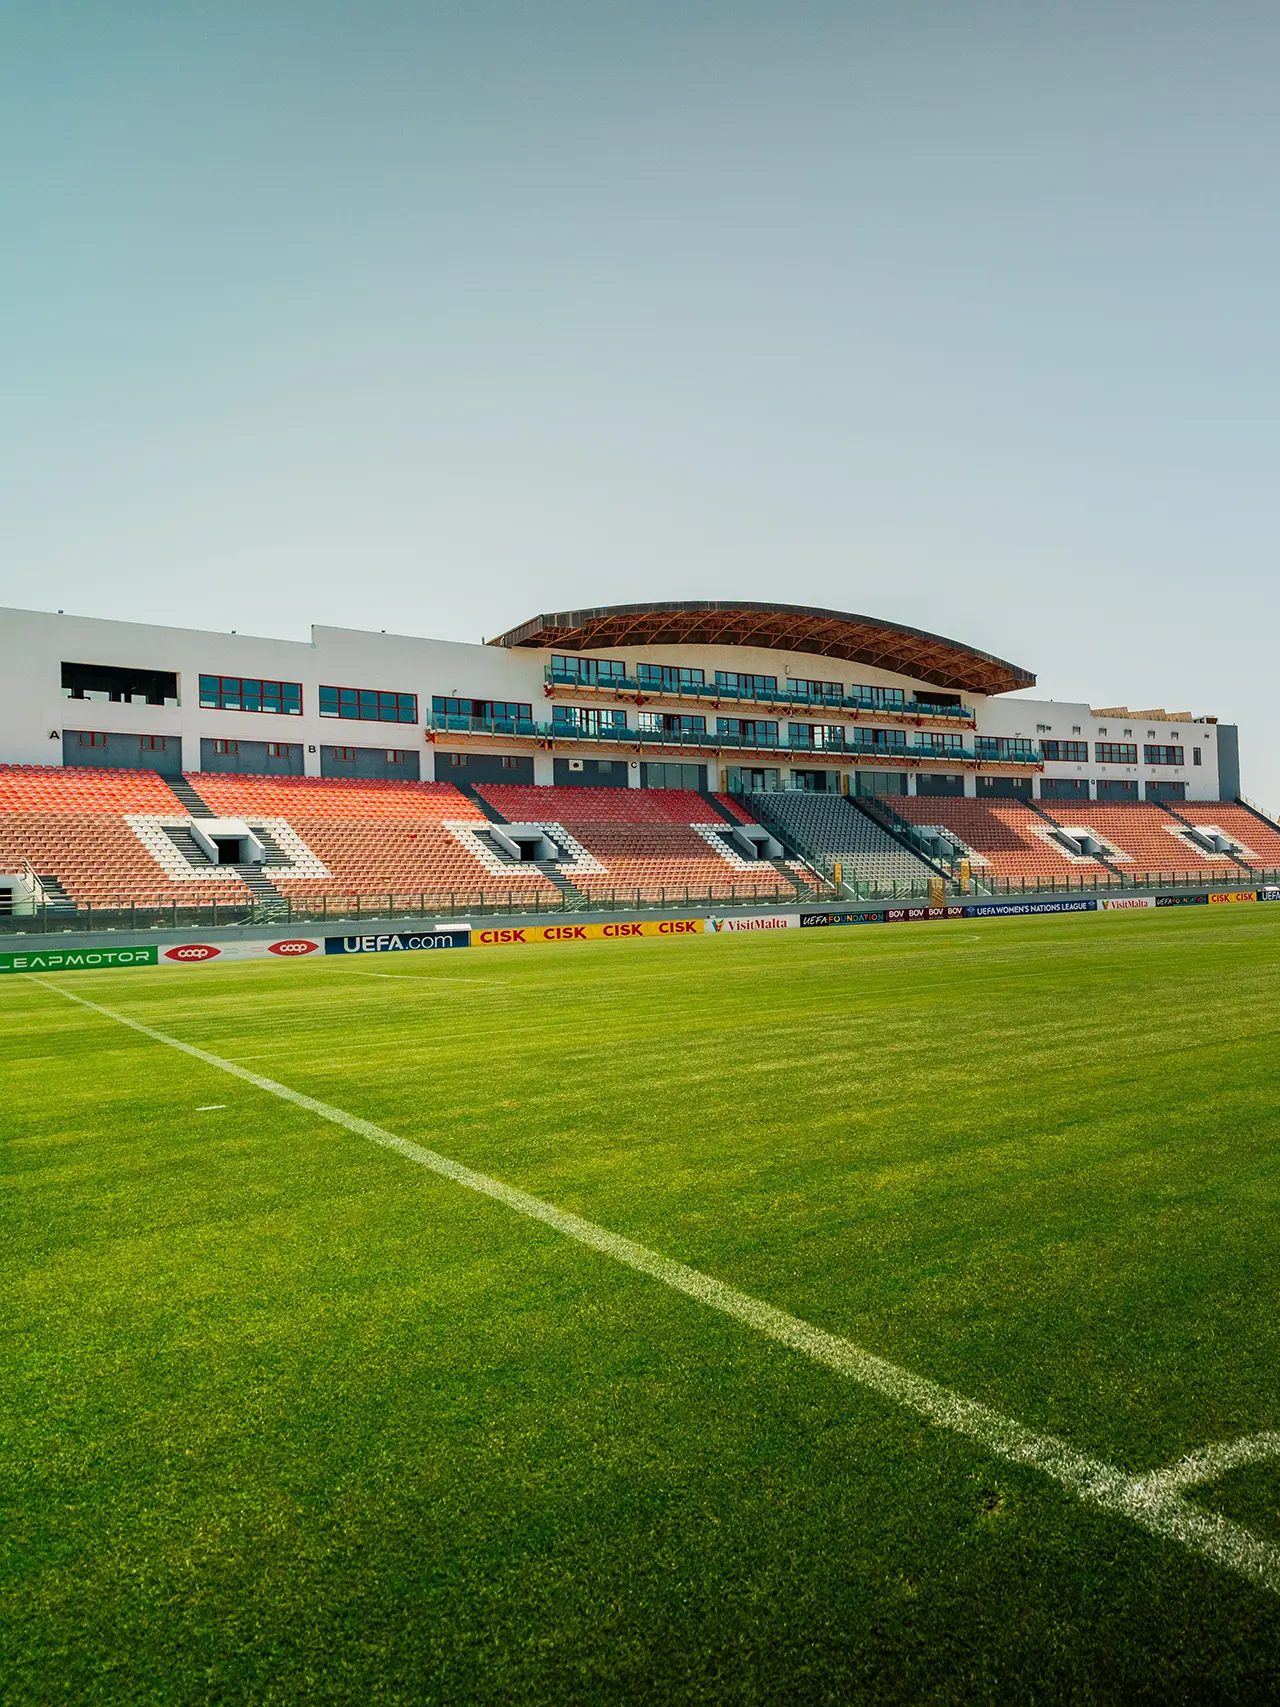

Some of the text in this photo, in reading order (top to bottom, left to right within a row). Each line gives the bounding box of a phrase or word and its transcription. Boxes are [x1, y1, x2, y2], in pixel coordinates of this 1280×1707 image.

[49, 730, 60, 739] A
[308, 745, 316, 753] B
[1211, 892, 1254, 903] CISK CISK
[977, 902, 1087, 915] UEFA WOMEN'S NATIONS LEAGUE
[1111, 899, 1148, 909] VisitMalta
[889, 910, 904, 918] BOV
[948, 907, 962, 915] BOV
[728, 918, 787, 931] VisitMalta
[803, 913, 884, 925] UEFA FOUNDATION
[480, 921, 697, 943] CISK CISK CISK CISK
[279, 943, 308, 954] coop
[344, 935, 452, 953] UEFA.com
[178, 949, 208, 958] coop
